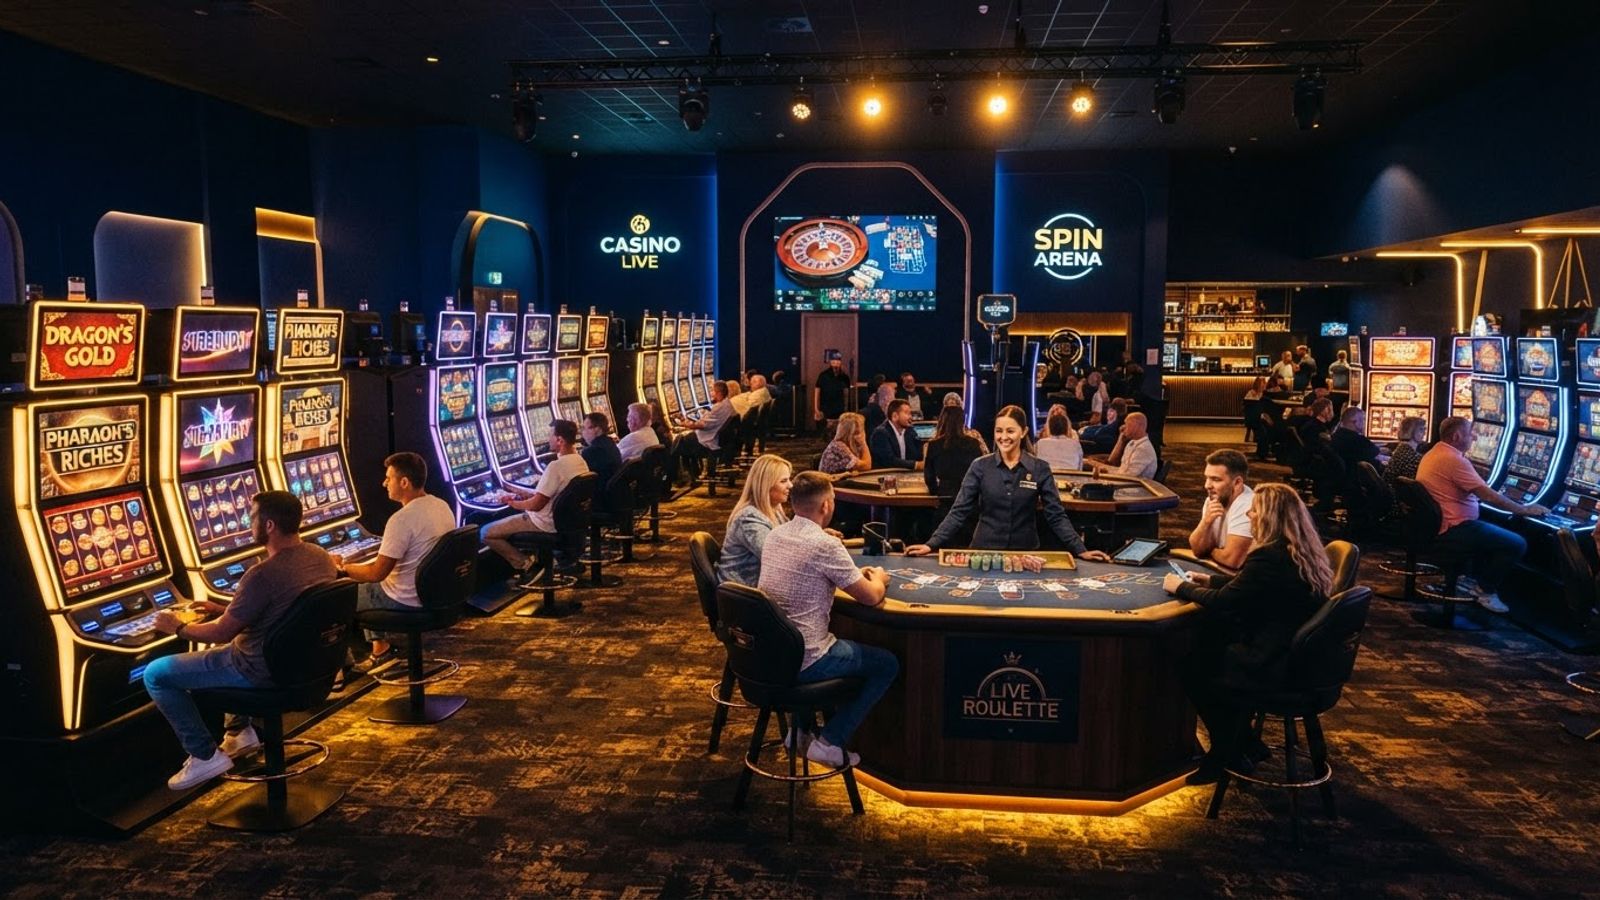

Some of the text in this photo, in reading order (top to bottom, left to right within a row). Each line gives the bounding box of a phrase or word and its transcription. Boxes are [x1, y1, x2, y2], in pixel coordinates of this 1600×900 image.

[600, 236, 681, 253] CASINO
[1034, 228, 1103, 250] SPIN
[621, 255, 659, 269] LIVE
[1033, 251, 1103, 267] ARENA
[45, 323, 134, 345] DRAGON'S
[64, 346, 116, 367] GOLD
[61, 444, 124, 472] RICHES
[990, 682, 1031, 700] LIVE
[963, 699, 1060, 719] ROULETTE
